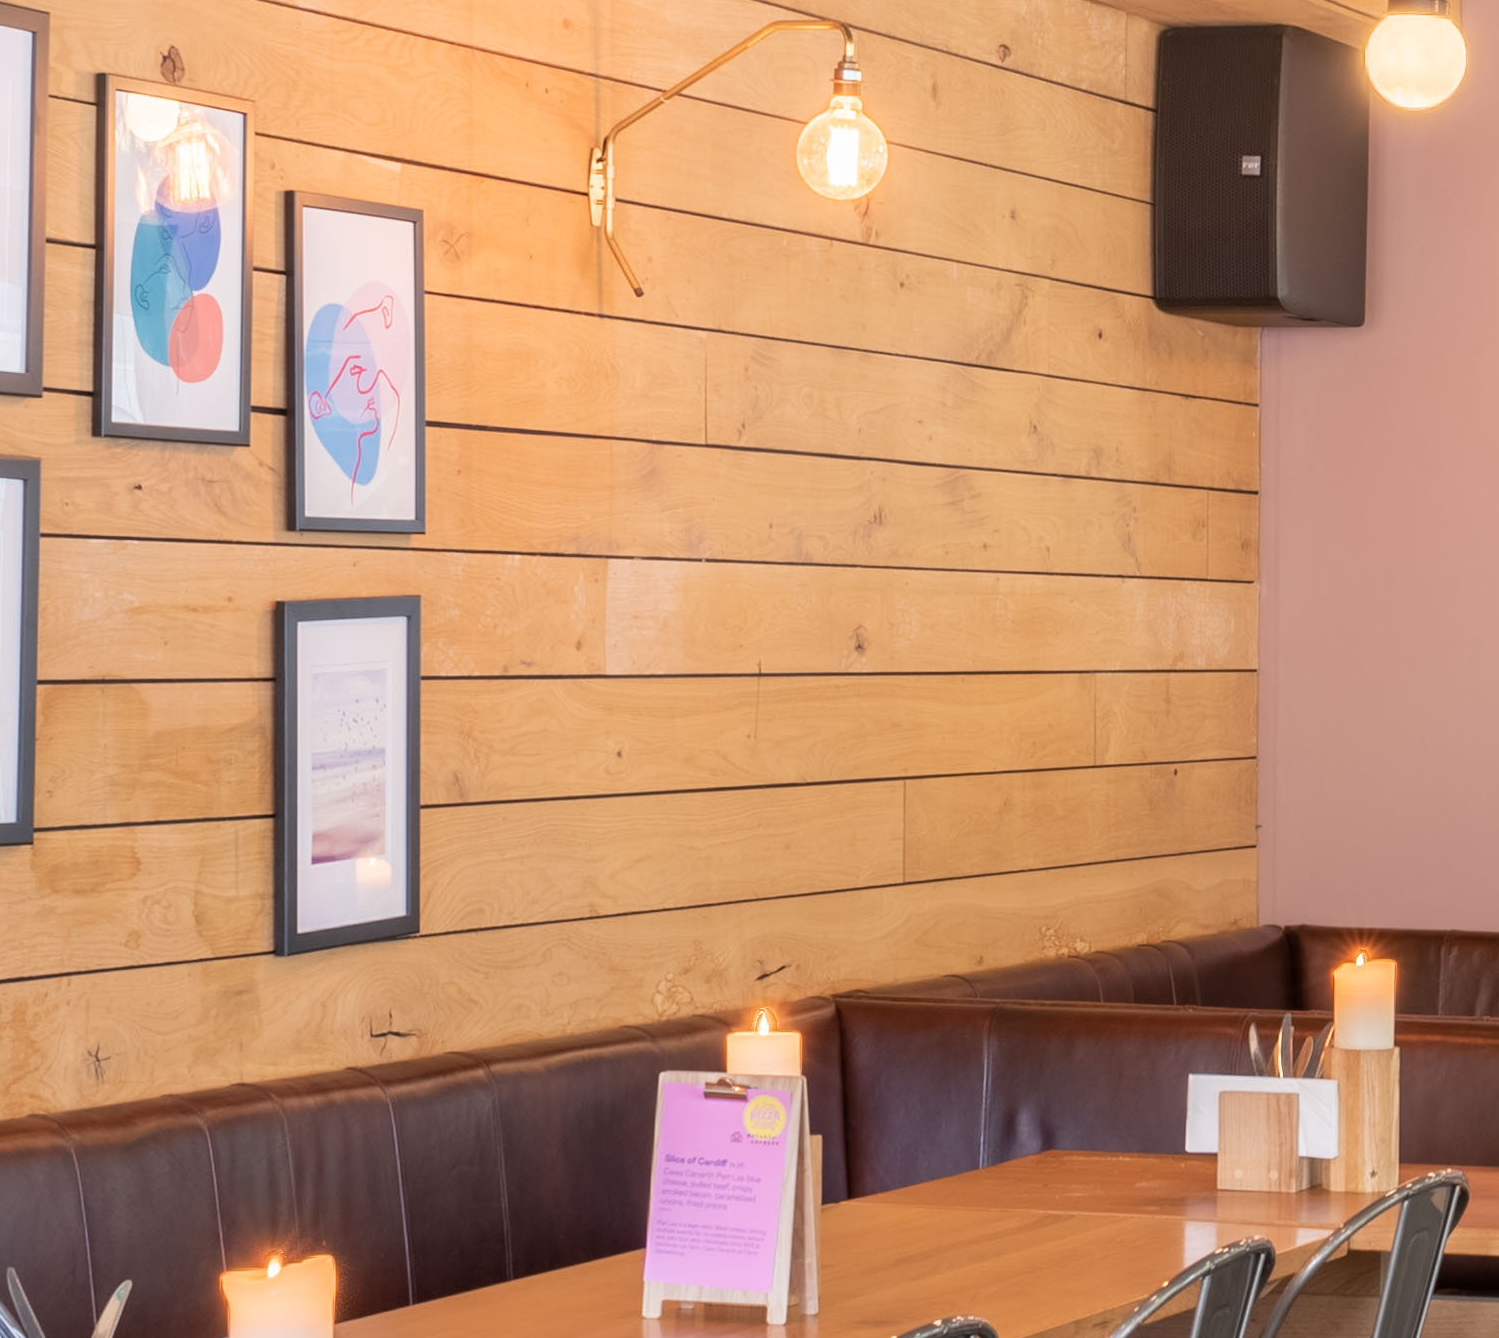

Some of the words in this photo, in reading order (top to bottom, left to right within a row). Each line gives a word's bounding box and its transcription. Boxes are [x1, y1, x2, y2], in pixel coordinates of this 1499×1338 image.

[665, 1154, 685, 1164] Slice
[687, 1156, 697, 1164] of
[697, 1157, 728, 1167] Cardiff
